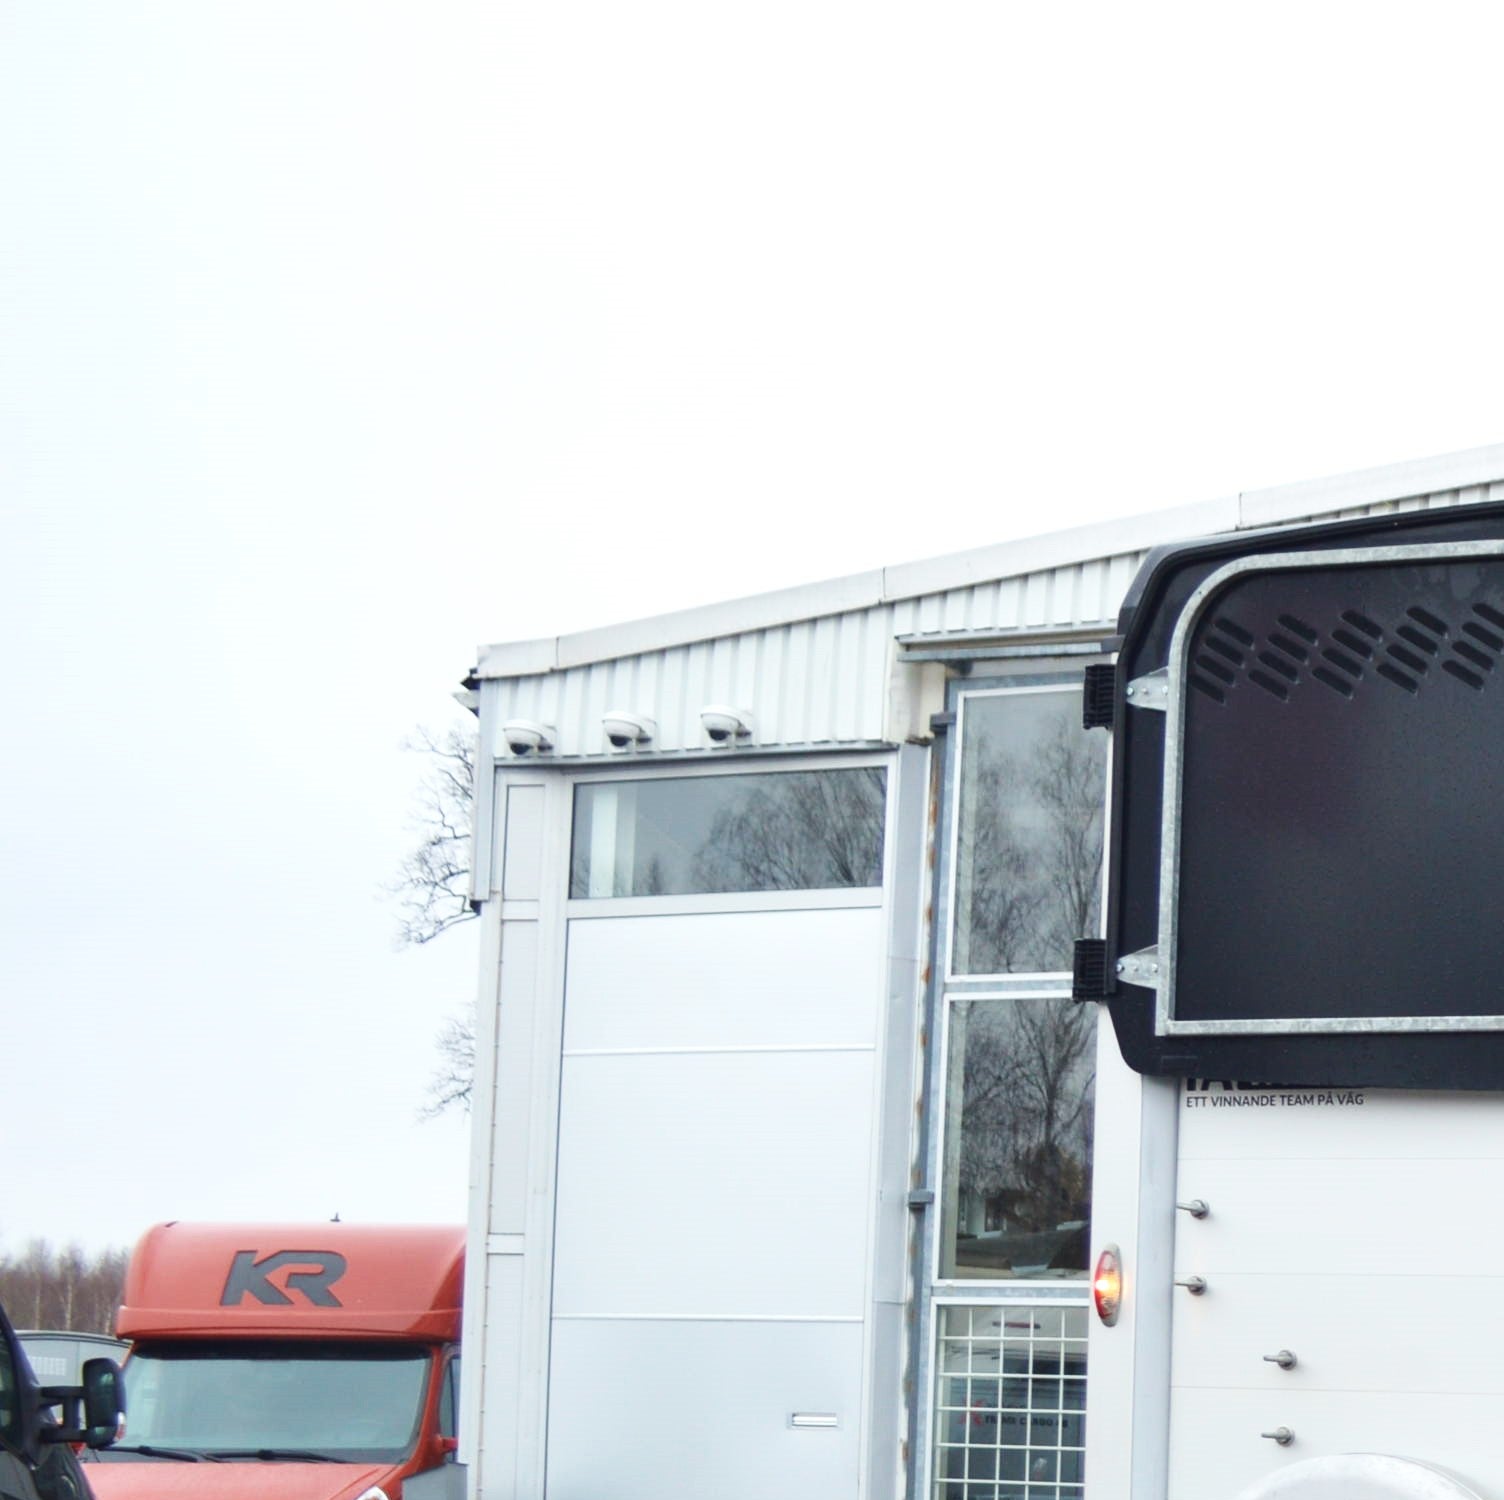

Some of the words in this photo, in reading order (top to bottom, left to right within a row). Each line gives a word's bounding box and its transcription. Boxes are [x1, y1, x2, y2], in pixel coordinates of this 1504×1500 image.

[1186, 1096, 1208, 1108] ETT
[1211, 1094, 1277, 1107] VINNANDE
[1280, 1093, 1314, 1106] TEAM
[1317, 1092, 1333, 1105] PÅ
[220, 1251, 346, 1306] KR
